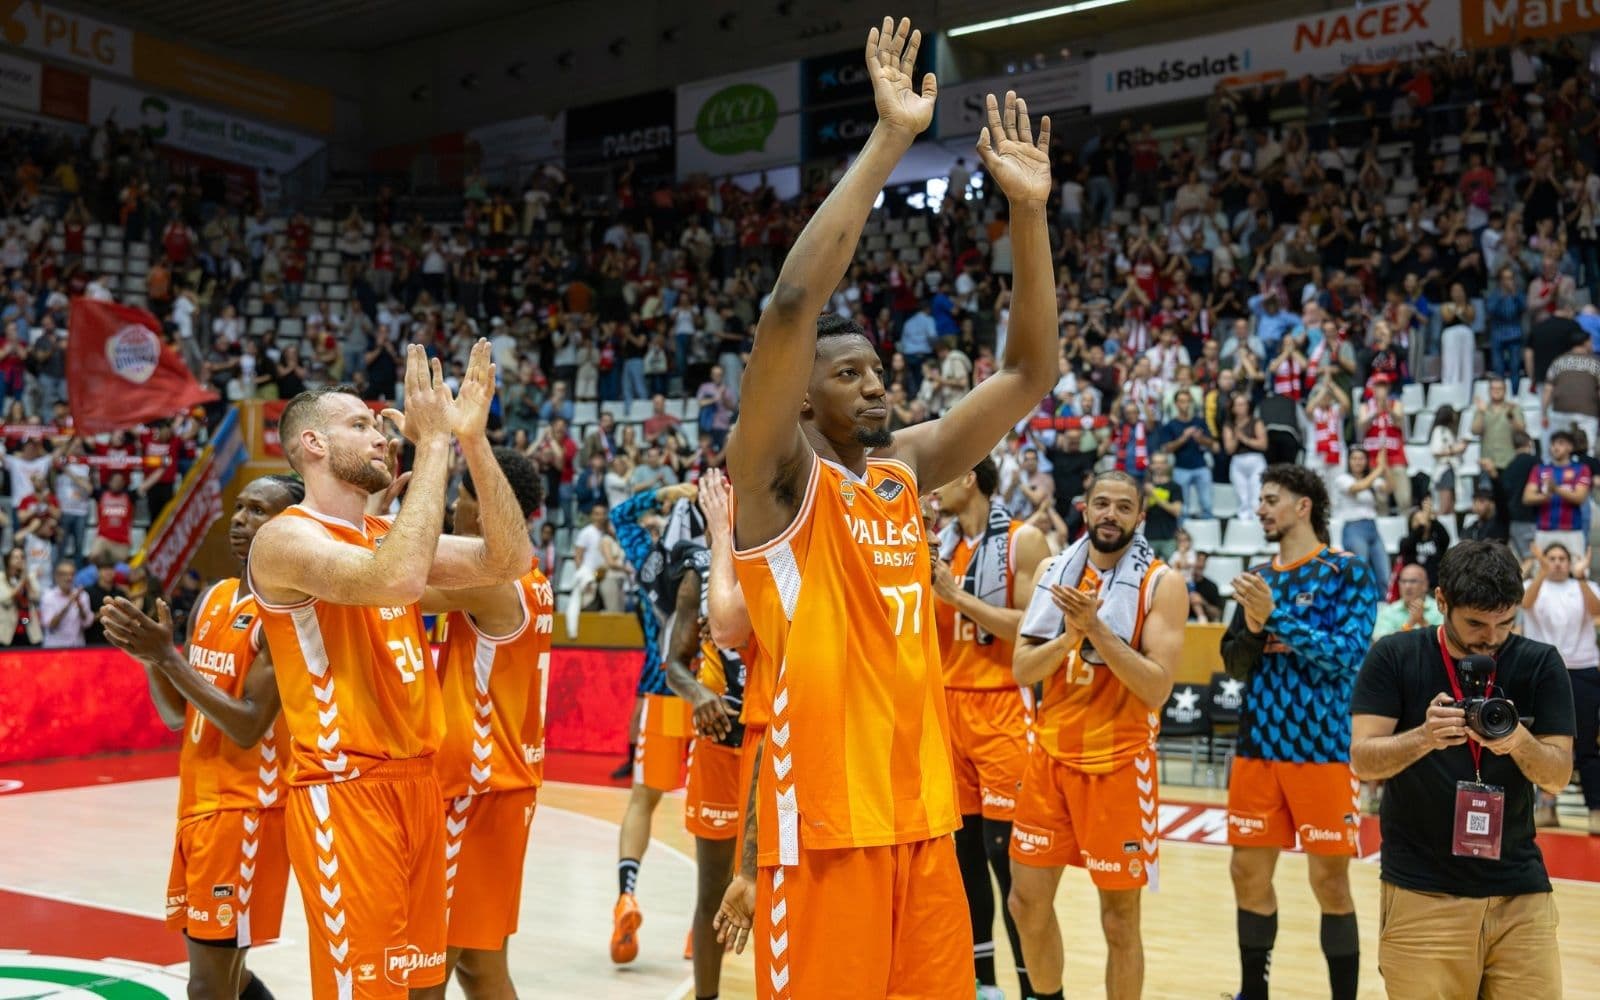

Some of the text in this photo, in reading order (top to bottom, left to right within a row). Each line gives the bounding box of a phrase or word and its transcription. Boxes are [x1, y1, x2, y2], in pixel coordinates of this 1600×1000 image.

[44, 11, 116, 65] PLG
[1294, 0, 1429, 53] NACEX
[1117, 53, 1239, 92] RibéSalat
[879, 582, 923, 636] 77
[387, 636, 424, 684] 24
[701, 807, 739, 820] PULEVA
[1013, 827, 1049, 846] PULEVA
